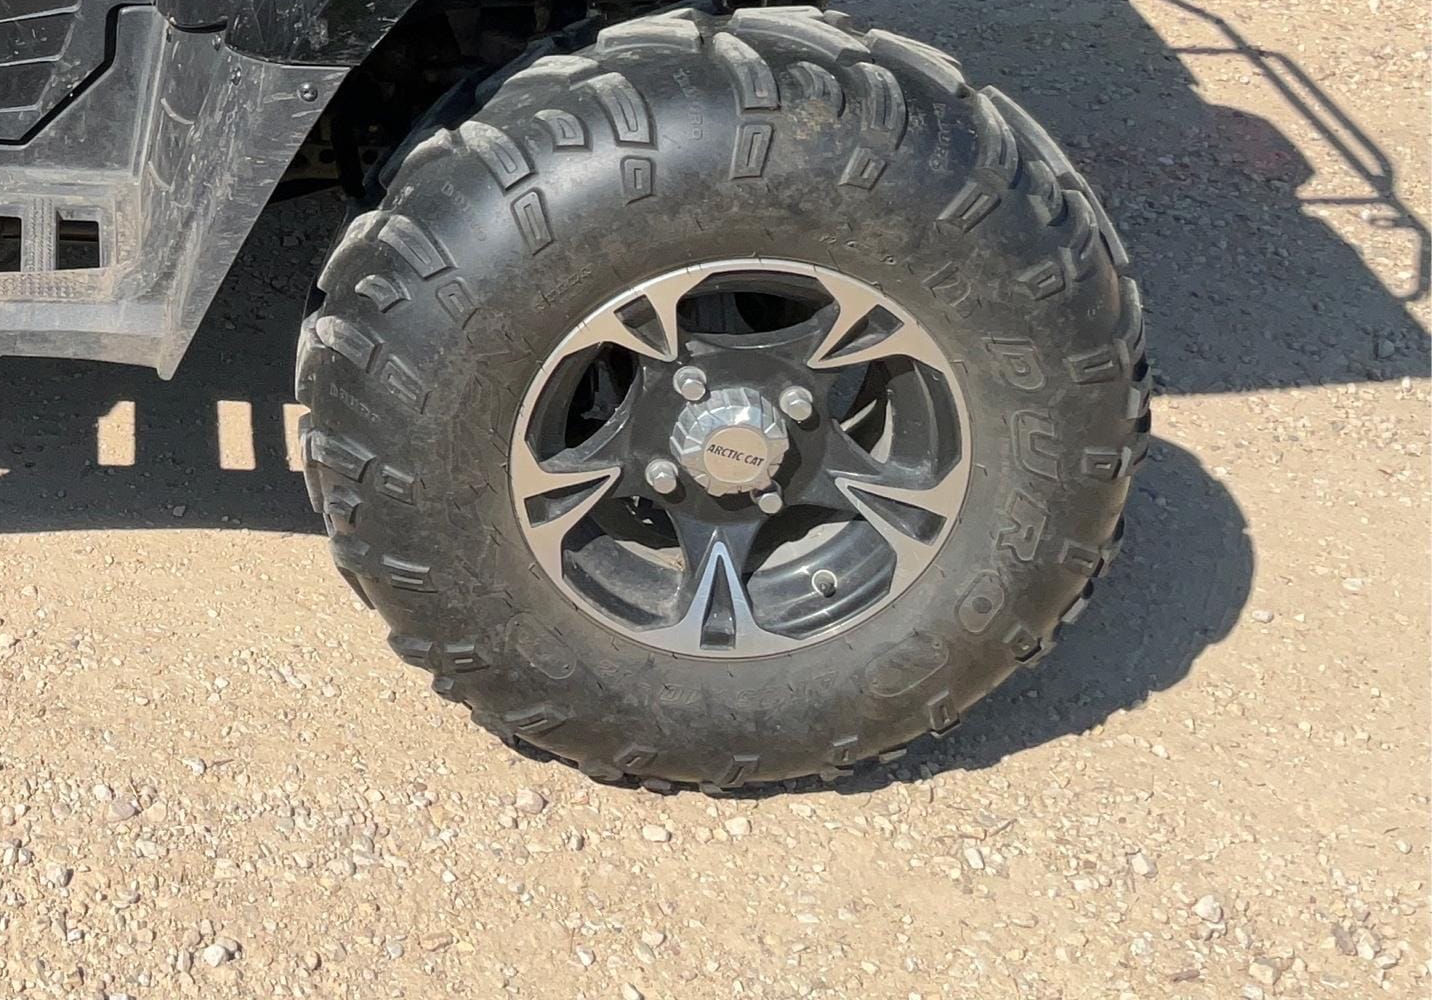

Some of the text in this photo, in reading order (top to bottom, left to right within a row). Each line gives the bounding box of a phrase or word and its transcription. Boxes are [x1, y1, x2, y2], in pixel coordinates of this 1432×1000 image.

[707, 444, 765, 467] ARCTIC CAT
[956, 336, 1064, 633] DURO
